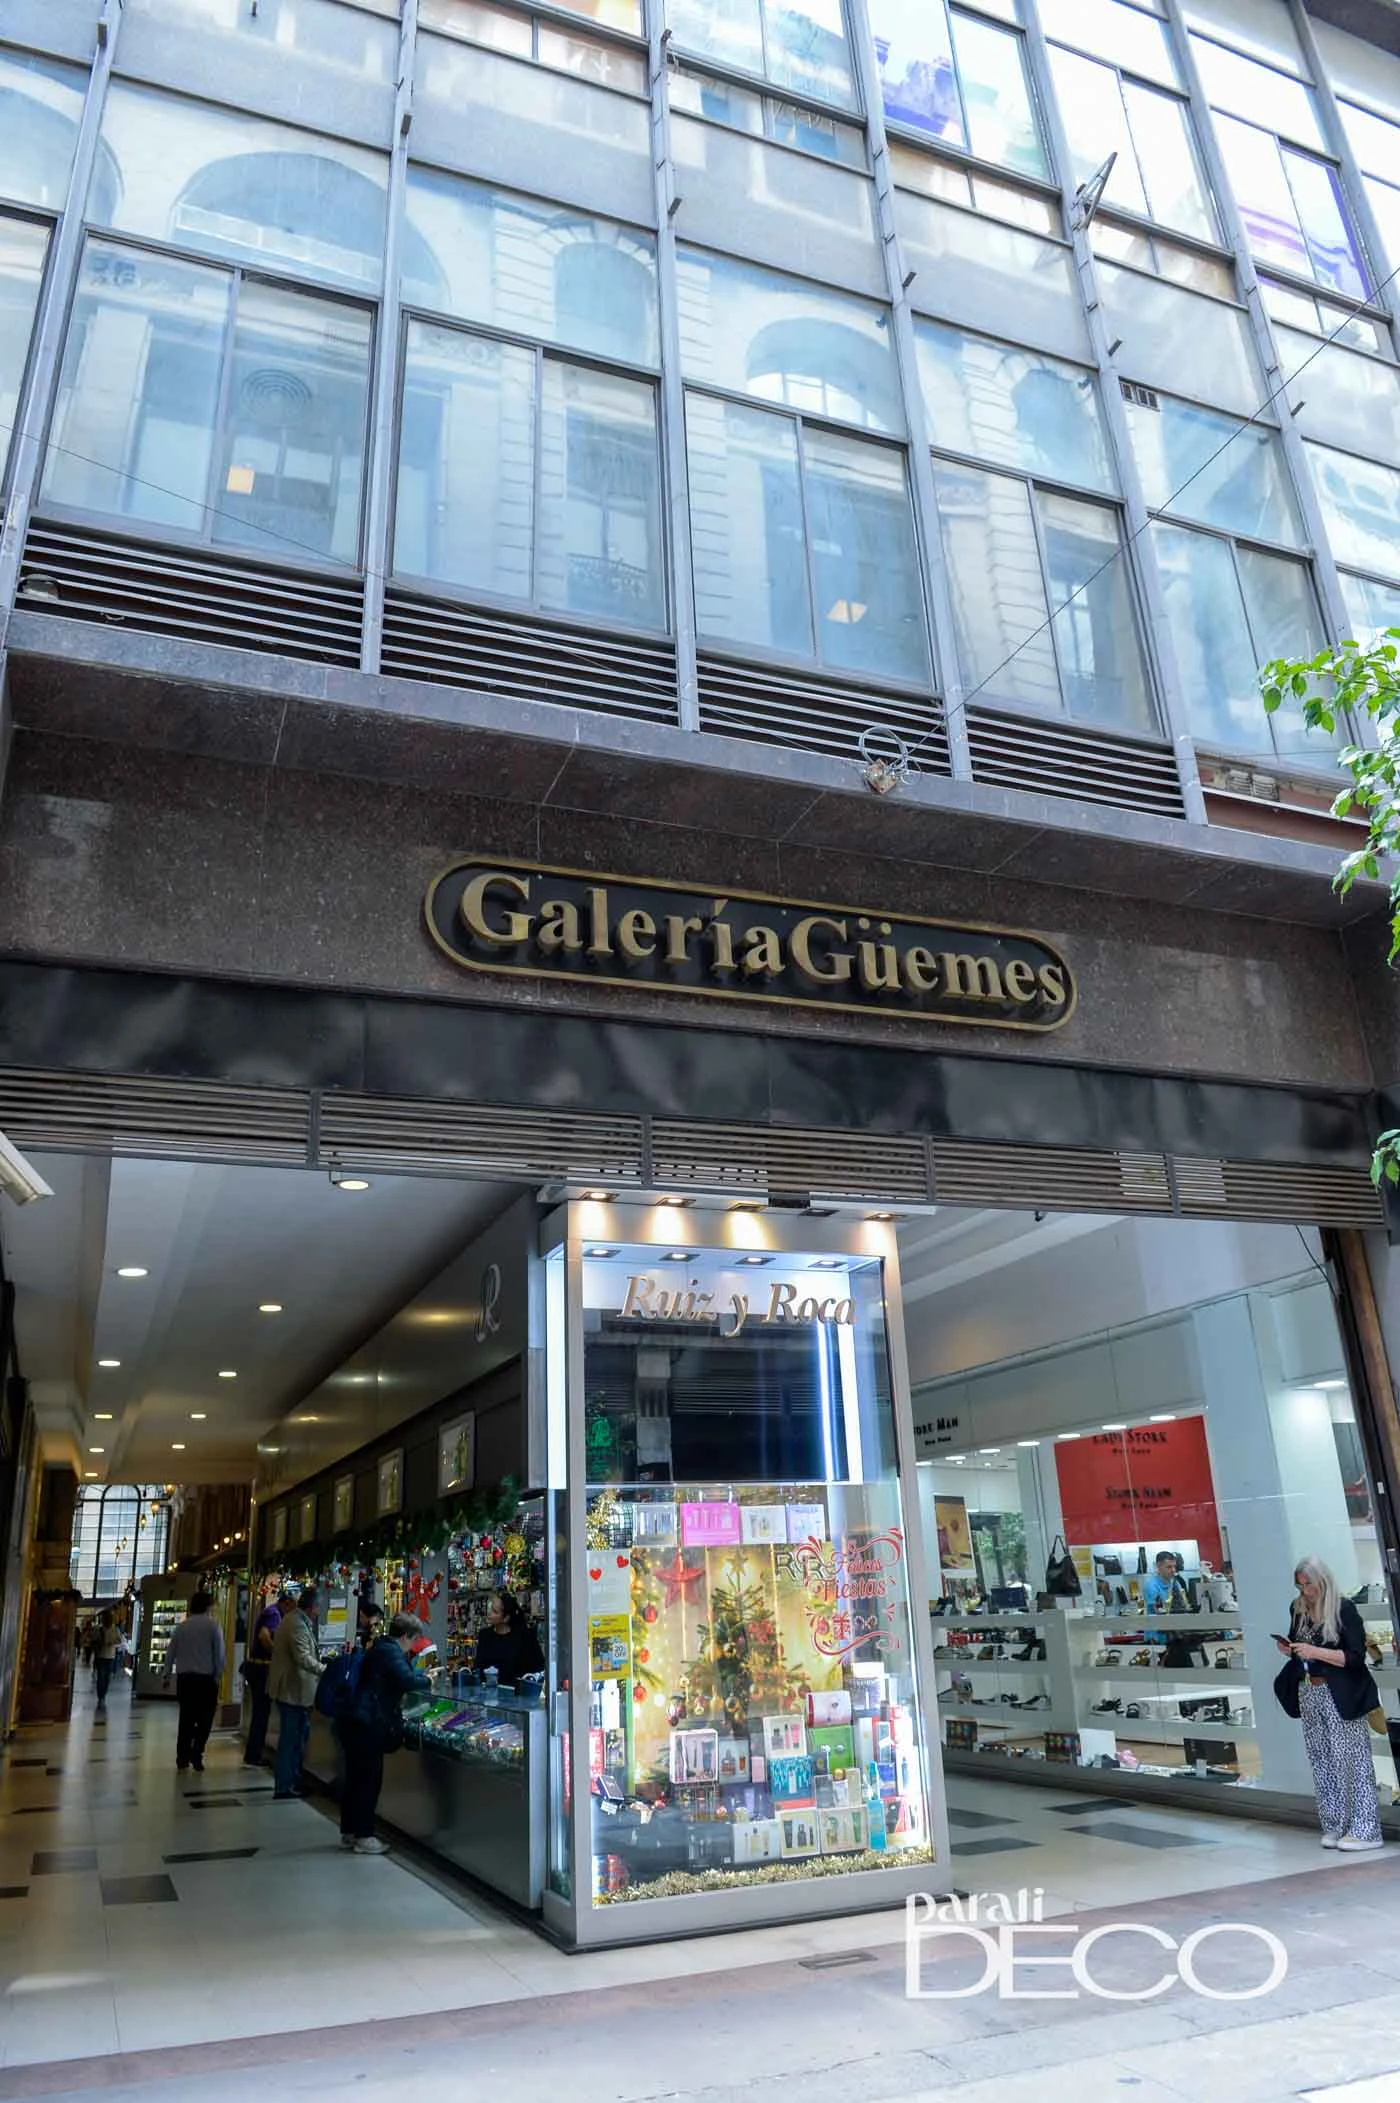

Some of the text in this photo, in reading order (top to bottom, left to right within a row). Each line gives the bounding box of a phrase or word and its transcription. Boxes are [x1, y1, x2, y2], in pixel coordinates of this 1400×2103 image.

[616, 1275, 857, 1338] Ruiz y Roca
